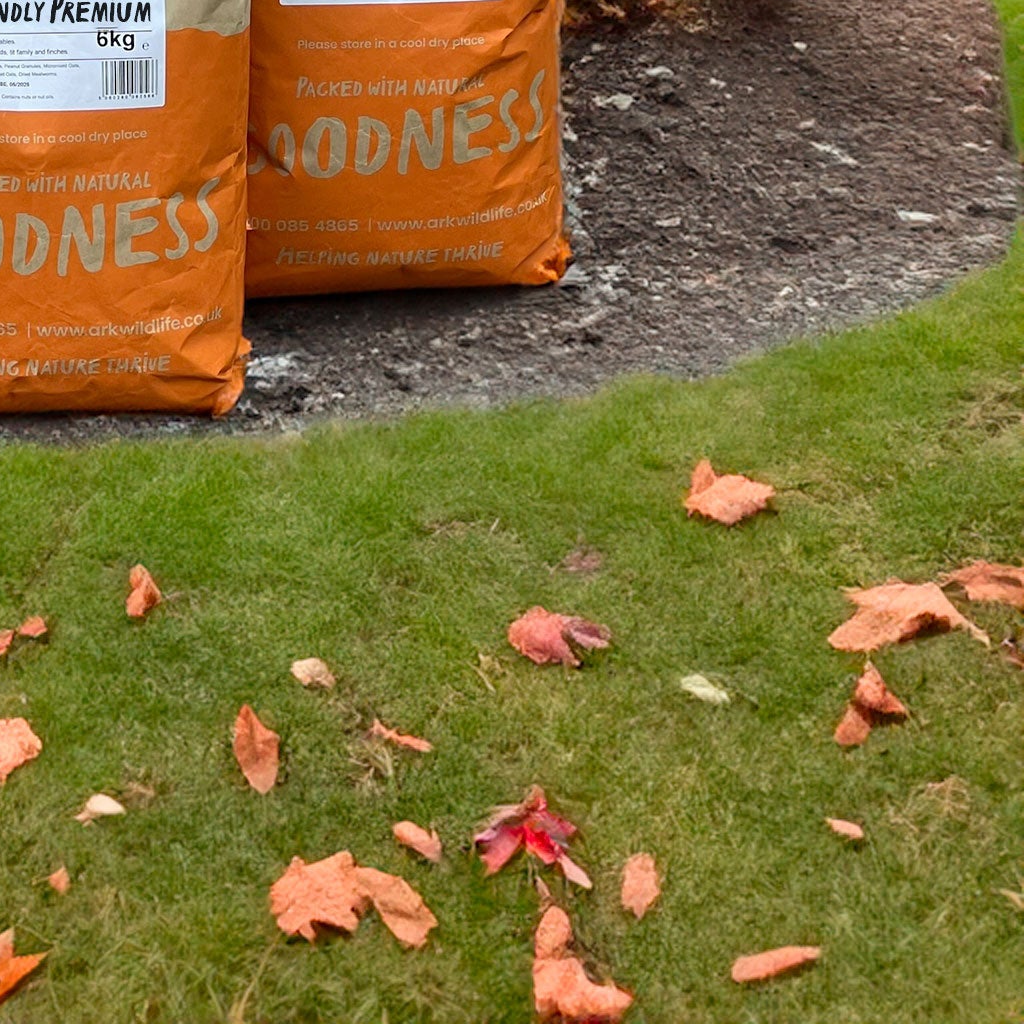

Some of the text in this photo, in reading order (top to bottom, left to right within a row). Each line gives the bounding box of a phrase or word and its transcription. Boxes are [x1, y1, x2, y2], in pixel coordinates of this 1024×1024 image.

[97, 30, 135, 51] 6kg
[297, 39, 337, 50] Please
[341, 38, 372, 49] store
[374, 38, 386, 49] in
[400, 37, 426, 49] cool
[428, 37, 448, 49] dry
[451, 35, 485, 49] place
[295, 73, 484, 98] PACKED WITH NATURAL
[0, 133, 30, 144] store
[33, 132, 45, 144] in
[59, 132, 86, 143] cool
[89, 131, 110, 144] dry
[113, 129, 149, 144] place
[26, 172, 66, 192] WITH
[72, 171, 152, 192] NATURAL
[276, 219, 309, 232] 085
[315, 219, 359, 232] 4865
[276, 241, 504, 265] HELPING NATURE THRIVE
[36, 306, 223, 337] www.arkwildlife.co.uk
[25, 355, 100, 377] NATURE
[106, 351, 171, 374] THRIVE
